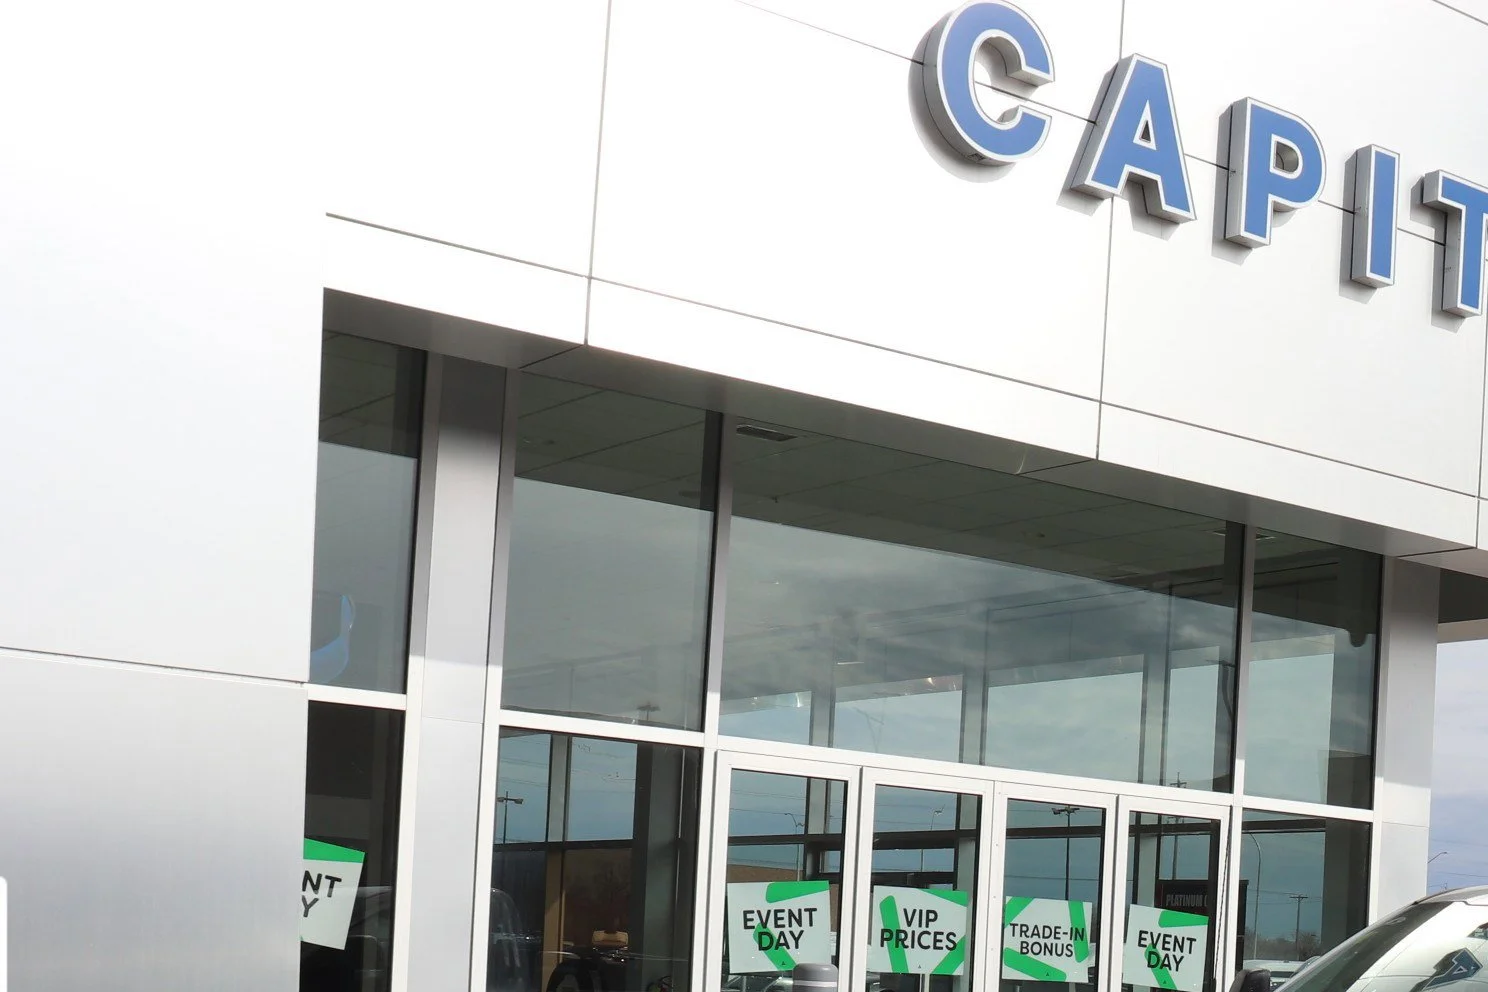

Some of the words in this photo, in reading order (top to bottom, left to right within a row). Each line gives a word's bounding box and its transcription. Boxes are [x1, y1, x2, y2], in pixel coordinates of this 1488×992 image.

[743, 907, 818, 930] EVENT
[903, 908, 938, 929] VIP
[757, 930, 804, 951] DAY
[880, 928, 957, 951] PRICES
[1009, 923, 1085, 942] TRADE-IN
[1137, 930, 1197, 955] EVENT
[1019, 941, 1074, 958] BONUS
[1147, 951, 1185, 972] DAY
